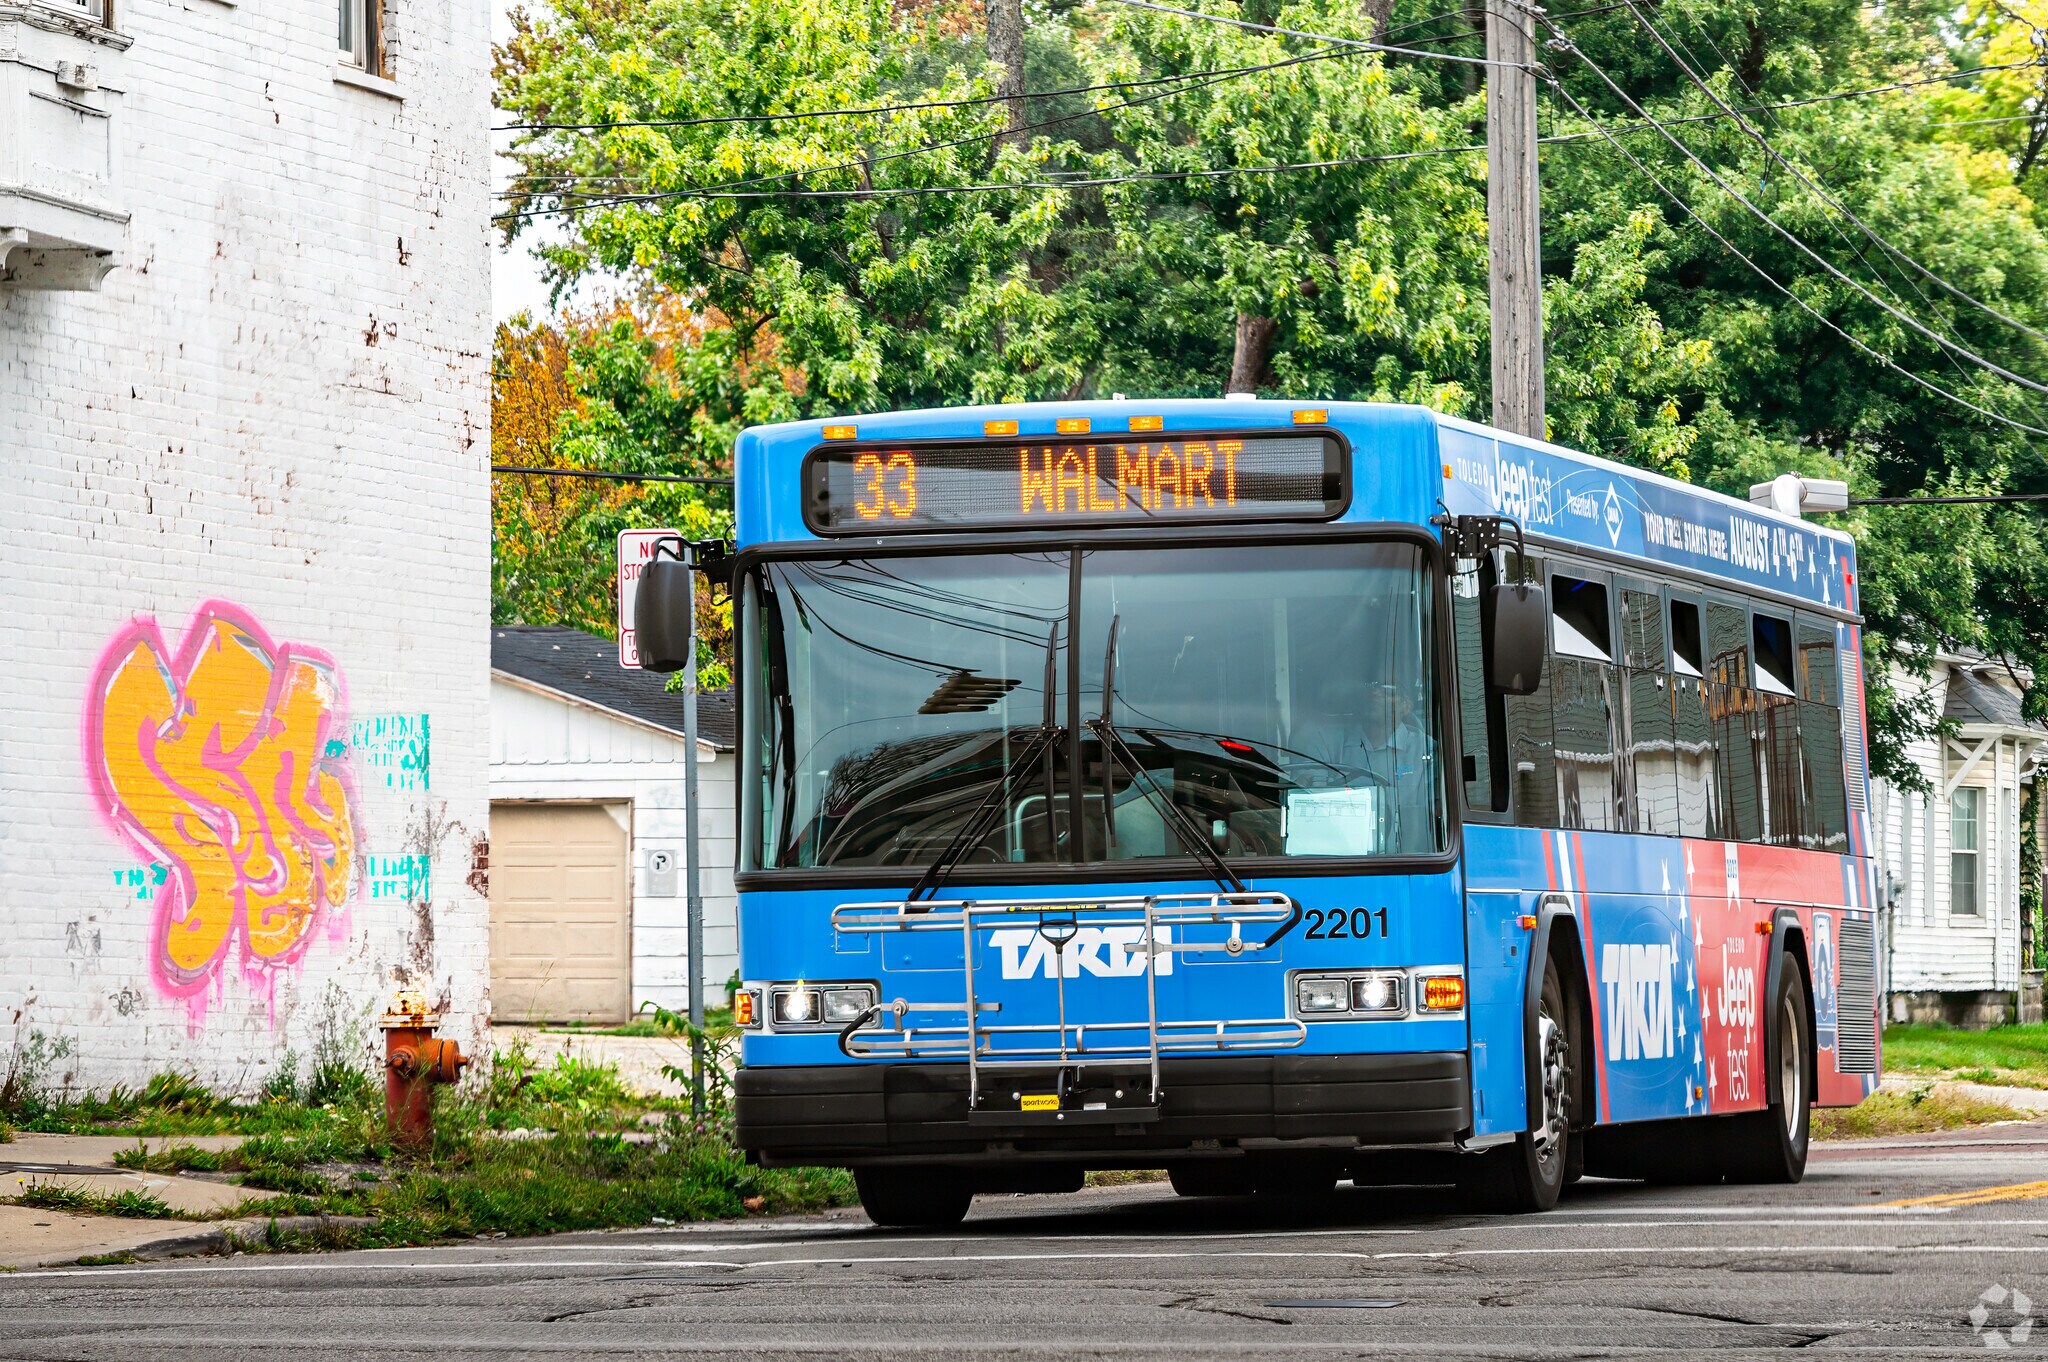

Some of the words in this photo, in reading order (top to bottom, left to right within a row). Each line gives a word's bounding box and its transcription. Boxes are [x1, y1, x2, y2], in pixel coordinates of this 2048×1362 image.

[855, 453, 916, 518] 33
[1020, 442, 1243, 513] WALMART
[1457, 457, 1489, 488] TOLEDO
[1490, 437, 1530, 535] Jeep
[1530, 459, 1553, 526] fest
[1566, 488, 1593, 519] Presented
[1645, 511, 1665, 546] YOUR
[1683, 521, 1708, 556] STARTS
[1729, 515, 1770, 574] AUGUST
[988, 925, 1174, 980] TARTA
[1304, 907, 1388, 940] 2201
[1601, 943, 1674, 1061] TARTA
[1717, 943, 1755, 1043] Jeep
[1727, 1032, 1749, 1101] fest
